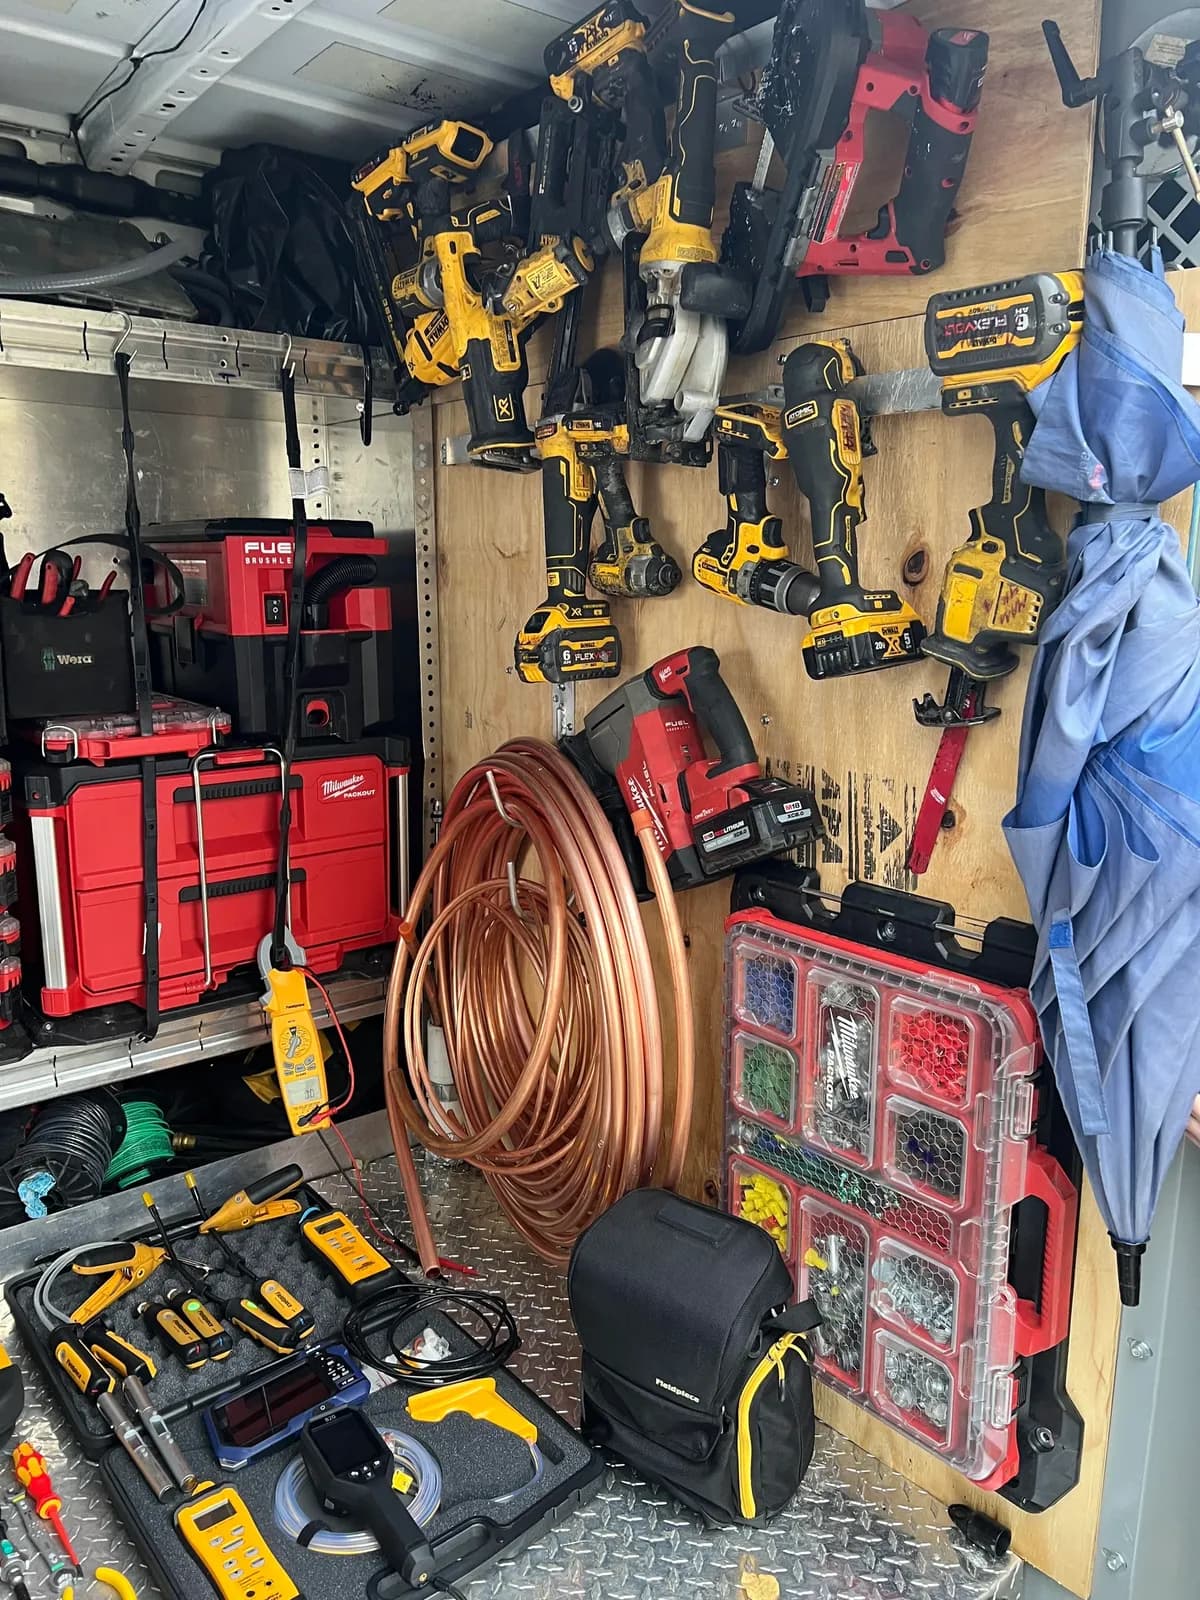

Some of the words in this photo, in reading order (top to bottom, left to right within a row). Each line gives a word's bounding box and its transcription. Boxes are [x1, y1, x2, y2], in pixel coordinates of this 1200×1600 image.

[1015, 313, 1030, 331] 6
[903, 632, 911, 645] 5
[56, 654, 92, 665] Wera
[562, 649, 571, 661] 6
[664, 720, 689, 728] FUEL
[320, 774, 365, 797] Milwaukee
[642, 760, 655, 797] FUEL
[343, 789, 376, 799] PACKOUT
[784, 800, 802, 814] M18
[836, 1013, 861, 1100] Milwaukee
[825, 1048, 836, 1112] PACKOUT
[655, 1376, 700, 1403] Fieldpiece
